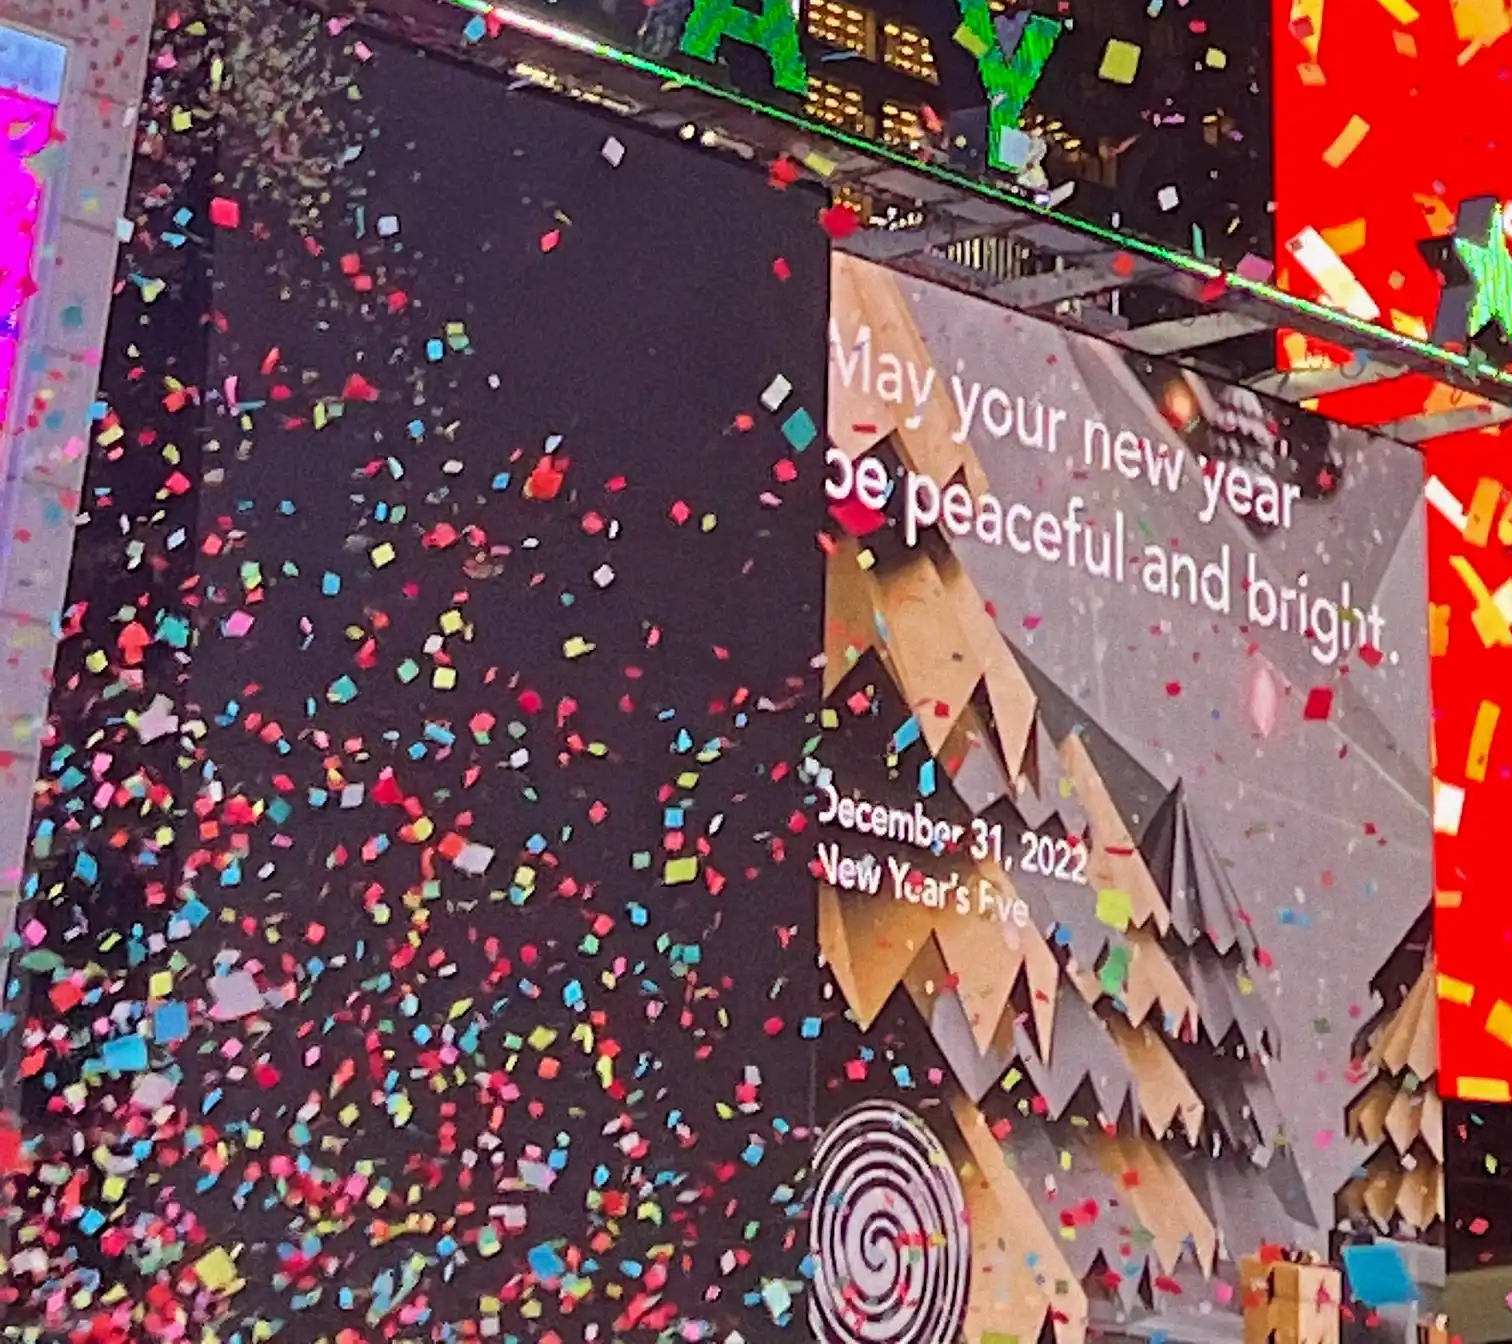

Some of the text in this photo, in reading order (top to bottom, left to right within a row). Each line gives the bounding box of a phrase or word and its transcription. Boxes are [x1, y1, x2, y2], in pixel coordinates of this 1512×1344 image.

[828, 316, 1301, 529] May your new year
[905, 470, 1124, 582] peaceful
[1142, 543, 1230, 614] and
[1247, 552, 1399, 665] bright.
[887, 854, 970, 915] Year's
[969, 817, 1013, 872] 31,
[1020, 830, 1088, 885] 2022
